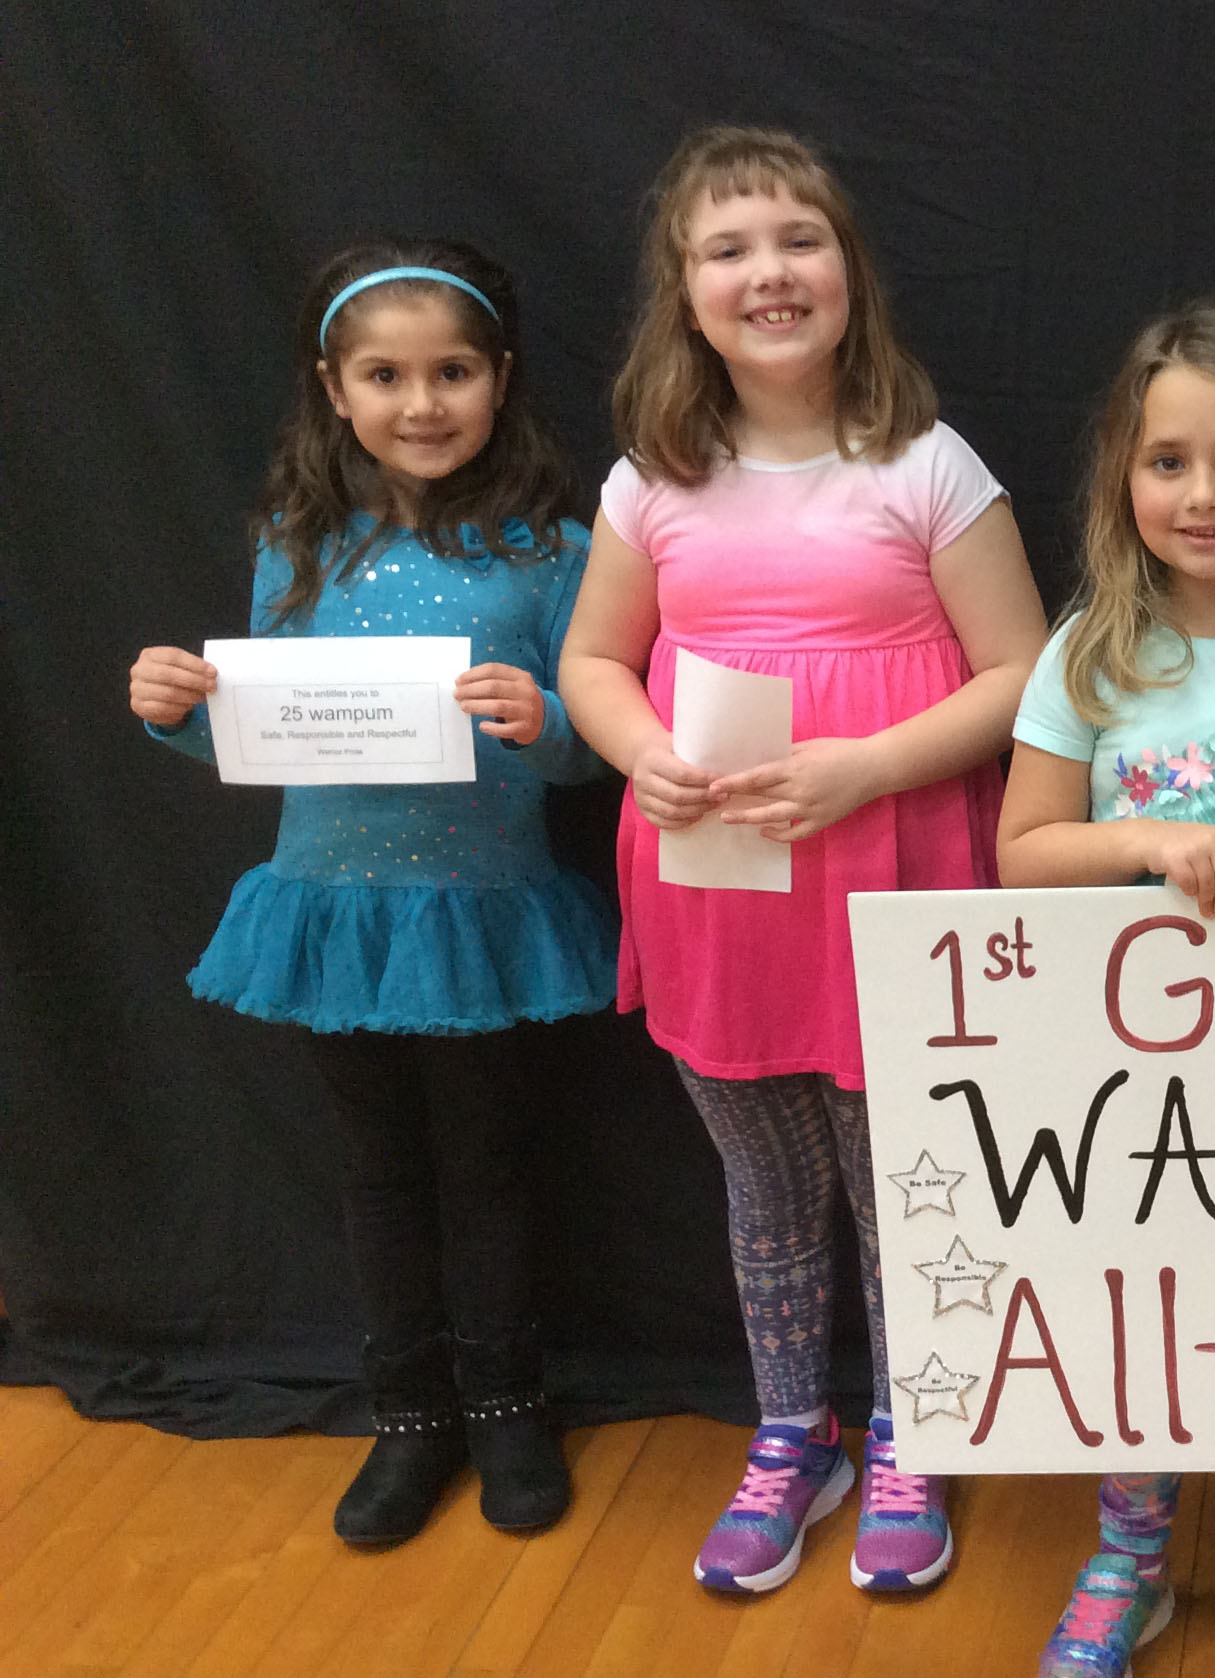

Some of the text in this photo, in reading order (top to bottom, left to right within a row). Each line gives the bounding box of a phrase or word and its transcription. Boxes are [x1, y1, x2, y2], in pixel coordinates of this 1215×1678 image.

[292, 688, 380, 700] This entitles you to
[280, 704, 394, 724] 25 wampum
[287, 729, 345, 741] Responsible
[347, 728, 365, 739] and
[367, 727, 417, 740] Respectful
[927, 916, 1037, 1048] 1st
[909, 1178, 947, 1188] Be Safe
[954, 1264, 966, 1272] Be
[934, 1273, 987, 1283] Responsible
